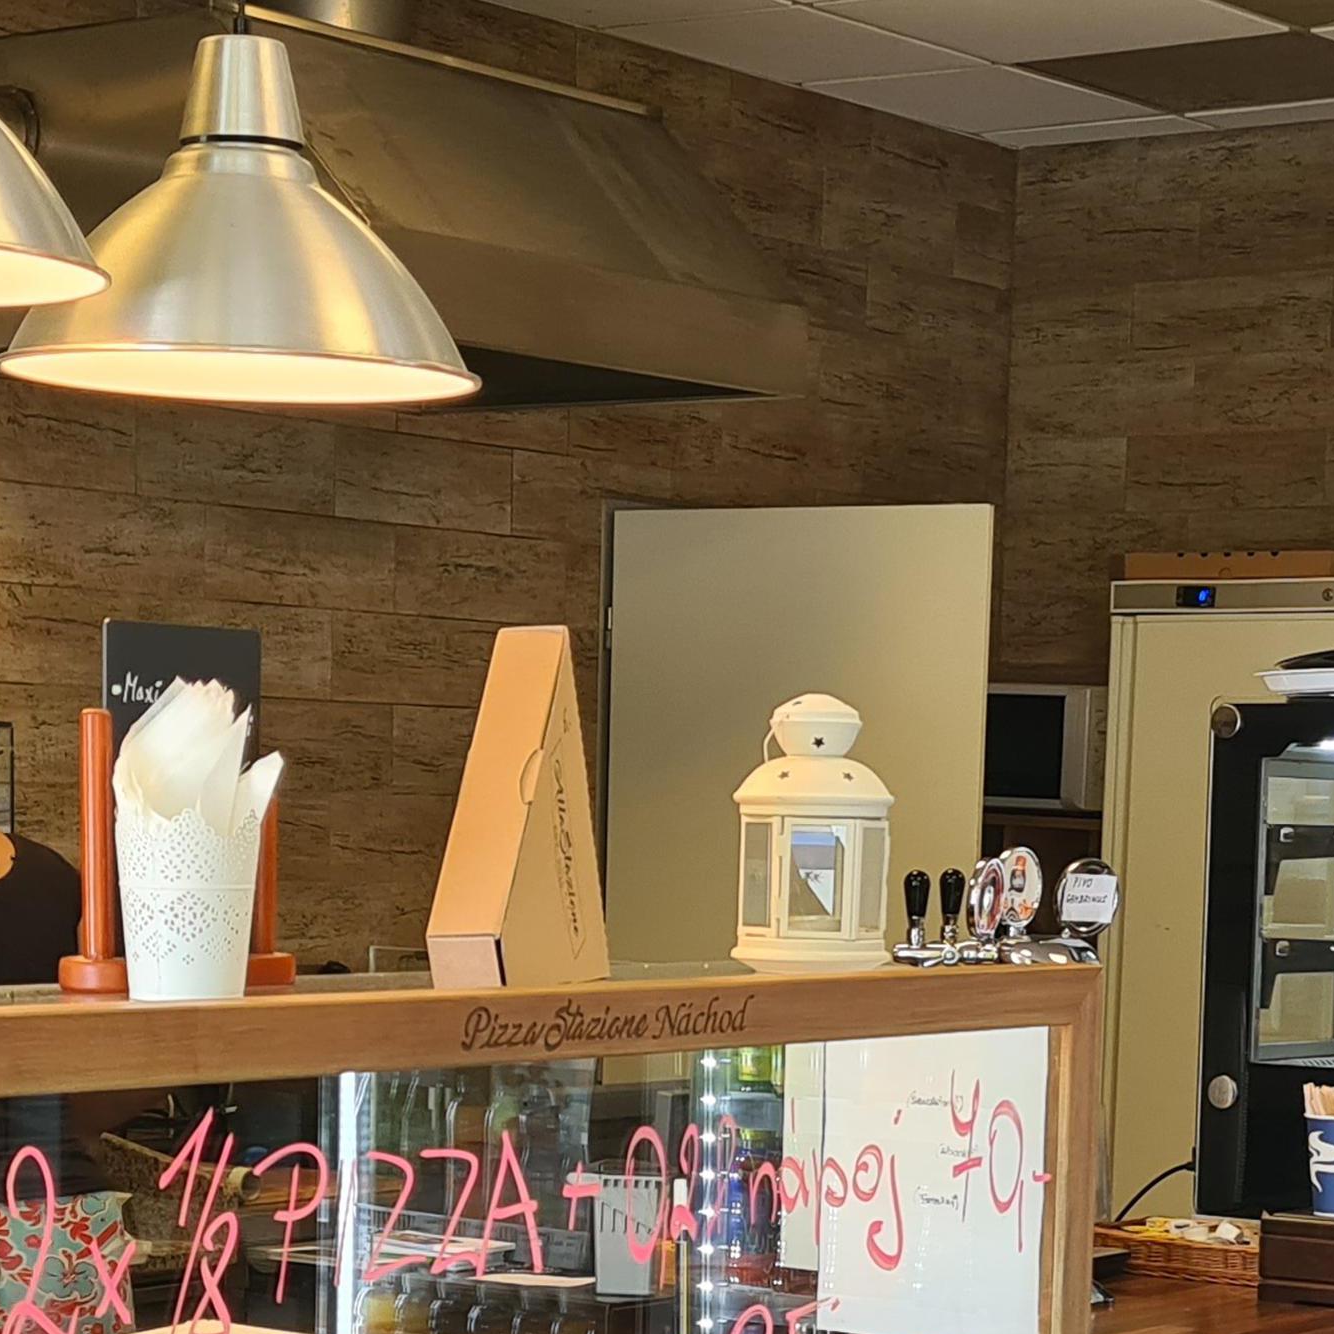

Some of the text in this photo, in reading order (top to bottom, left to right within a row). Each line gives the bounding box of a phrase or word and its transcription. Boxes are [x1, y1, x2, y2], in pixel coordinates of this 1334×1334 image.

[461, 994, 755, 1051] Pizza Stazione Náchod
[252, 1129, 545, 1304] PIZZA
